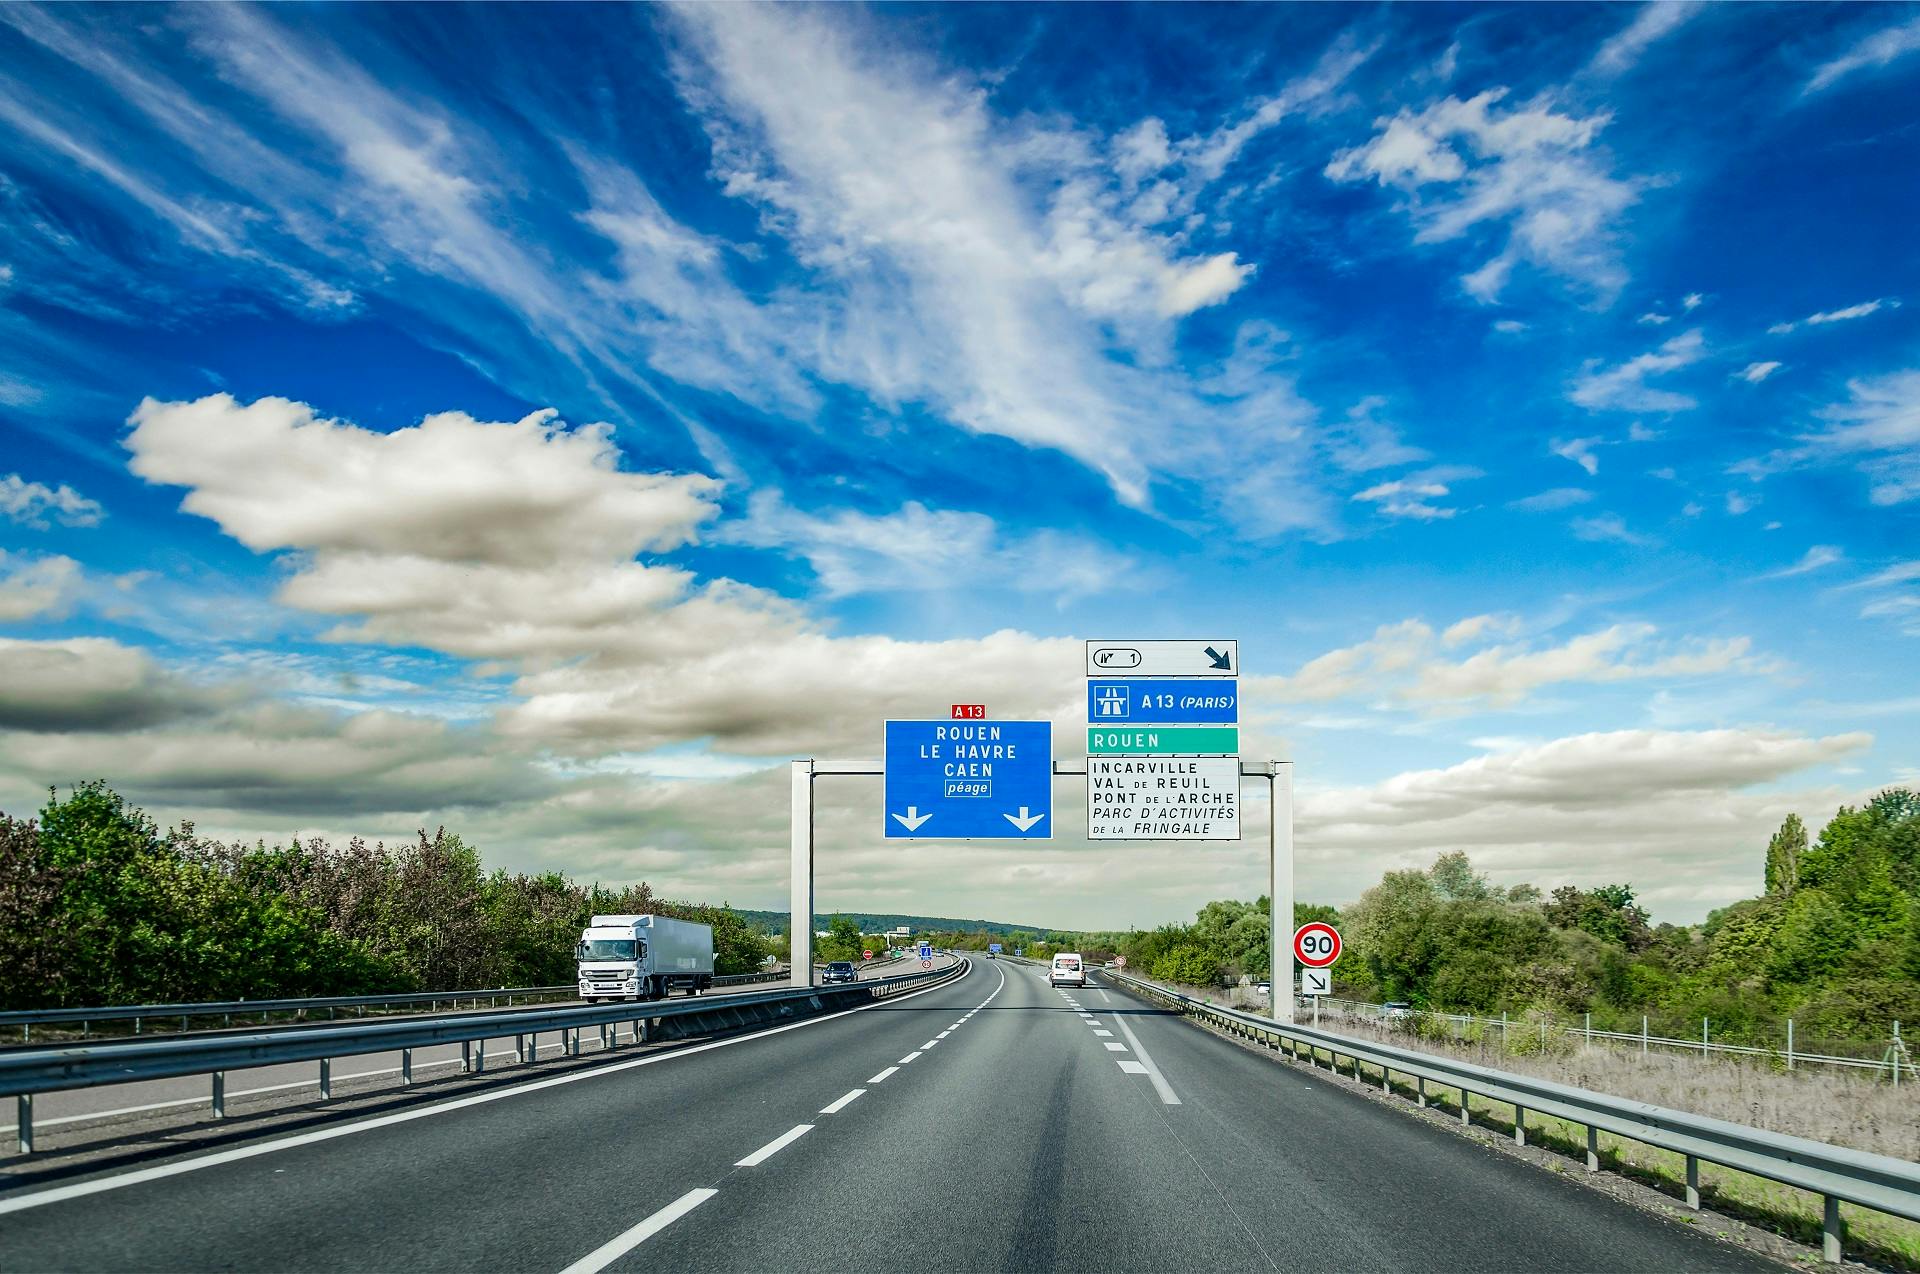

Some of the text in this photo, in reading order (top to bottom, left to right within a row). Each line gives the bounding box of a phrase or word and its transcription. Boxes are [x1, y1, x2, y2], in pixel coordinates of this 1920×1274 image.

[1130, 653, 1136, 664] 1
[1141, 695, 1235, 709] A 13 (PARIS)
[954, 706, 983, 717] A 13
[936, 727, 1000, 740] ROUEN
[1094, 734, 1158, 747] ROUEN
[920, 745, 1016, 759] LE HAVRE
[944, 763, 992, 777] CAEN
[1093, 762, 1197, 774] INCARVILLE
[947, 782, 988, 795] péage
[1094, 778, 1210, 789] VAL DE REUIL
[1093, 793, 1137, 804] PONT
[1145, 796, 1159, 804] DE
[1093, 807, 1132, 819] PARC
[1093, 823, 1210, 834] DE LA FRINGALE
[1303, 936, 1333, 954] 90
